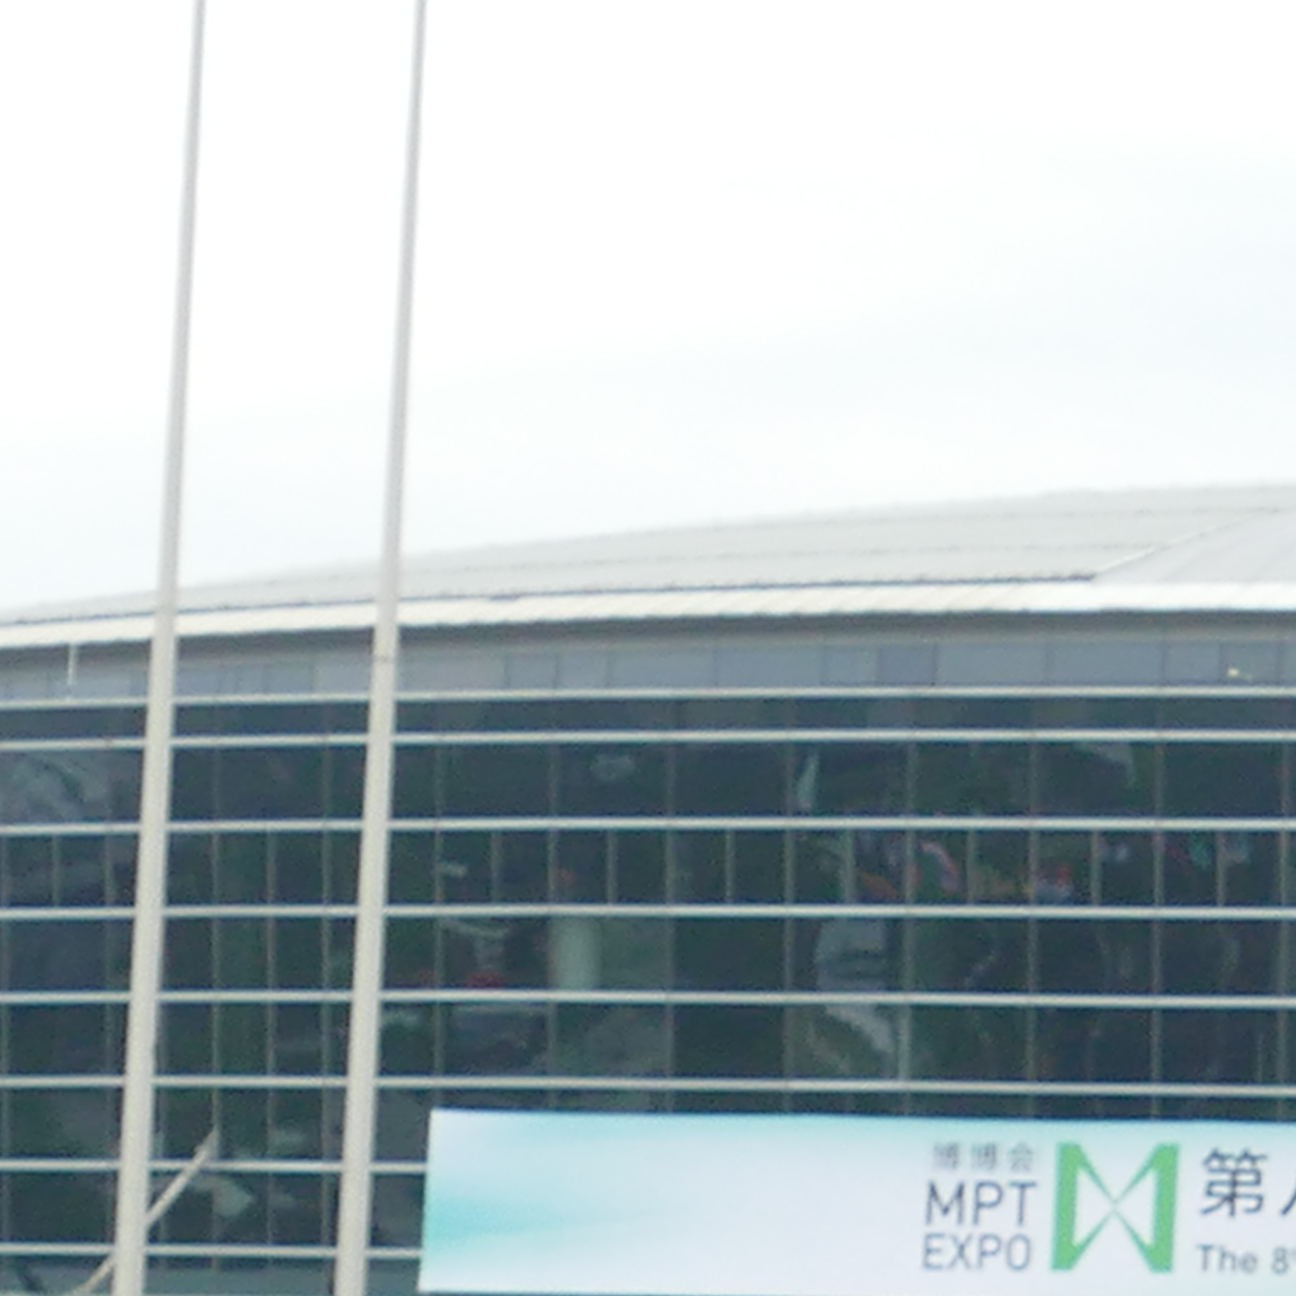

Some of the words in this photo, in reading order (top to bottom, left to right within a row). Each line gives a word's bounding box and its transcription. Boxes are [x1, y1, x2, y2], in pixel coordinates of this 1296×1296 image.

[924, 1180, 1038, 1227] MPT
[921, 1232, 1032, 1272] EXPO
[1197, 1243, 1258, 1275] The
